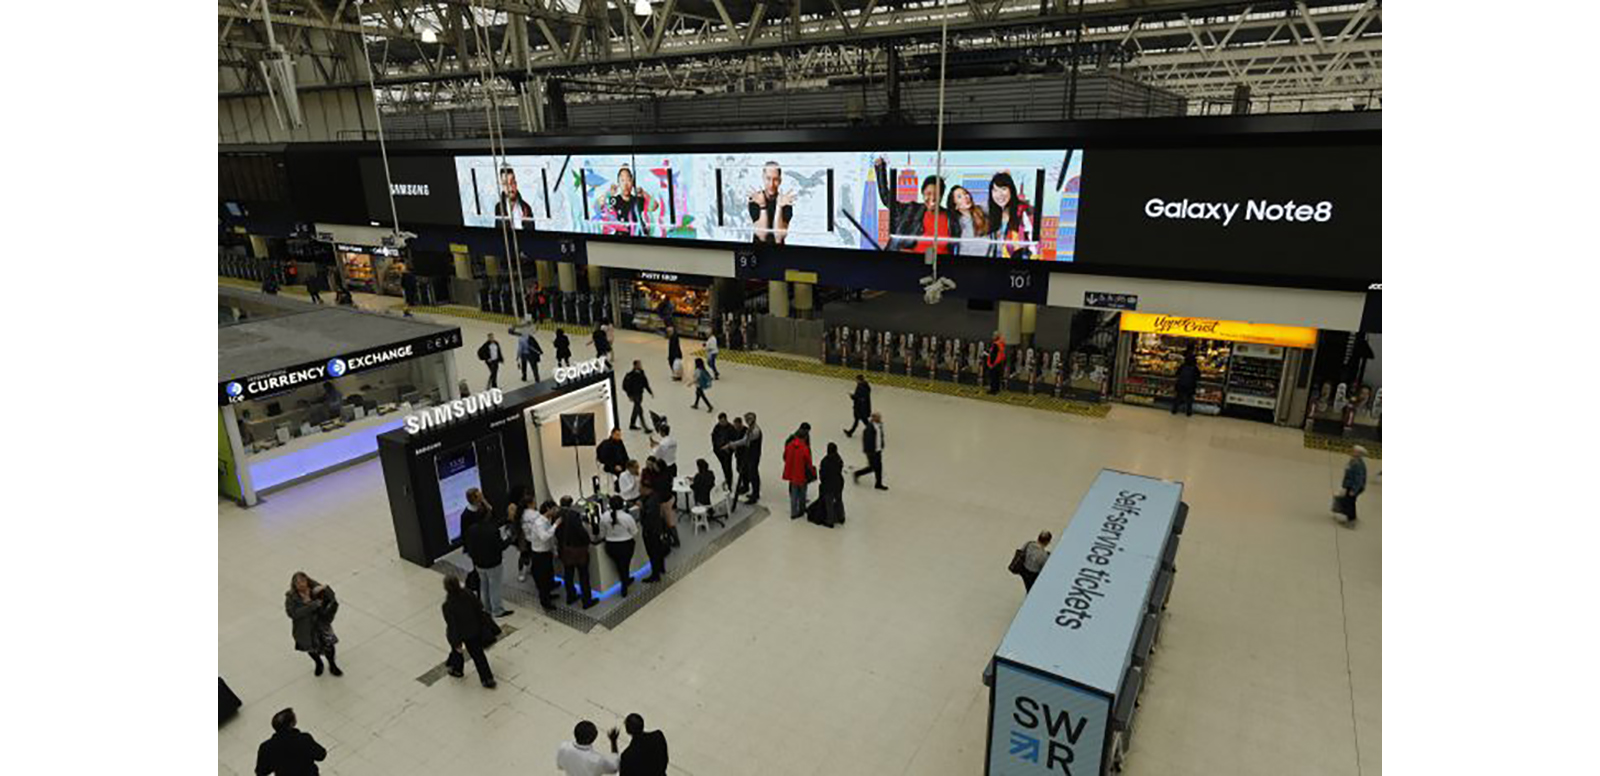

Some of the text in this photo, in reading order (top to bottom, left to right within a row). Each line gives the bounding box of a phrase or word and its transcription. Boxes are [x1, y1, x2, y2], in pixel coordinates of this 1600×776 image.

[1144, 198, 1333, 226] Galaxy Note8
[1009, 275, 1025, 289] 10
[1153, 316, 1220, 333] Upper Crust
[247, 365, 326, 394] CURRENCY
[347, 344, 414, 370] EXCHANGE
[554, 356, 607, 383] Galaxy
[404, 388, 503, 434] SAMSUNG
[1055, 490, 1147, 630] Self-service tickets
